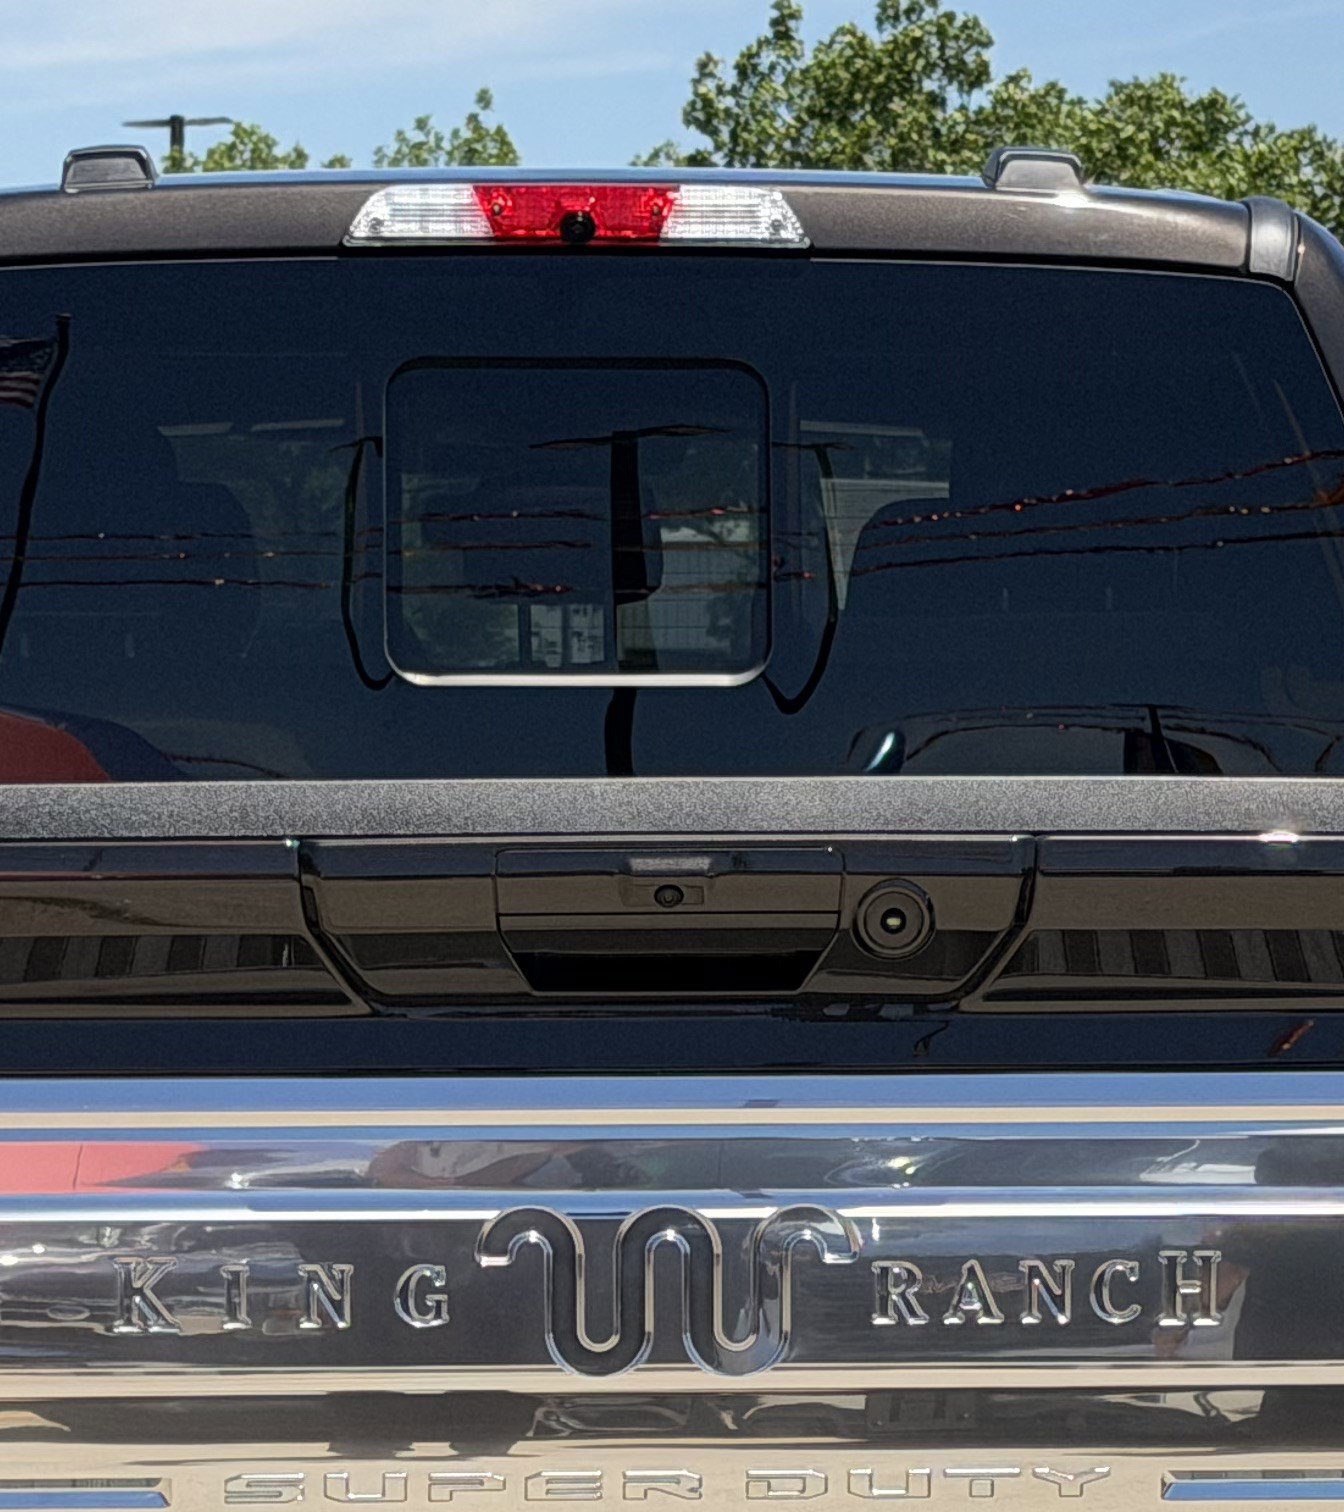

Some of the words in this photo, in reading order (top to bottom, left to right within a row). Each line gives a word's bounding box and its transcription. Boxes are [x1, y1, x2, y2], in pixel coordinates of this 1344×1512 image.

[112, 1253, 451, 1335] KING
[868, 1250, 1224, 1328] RANCH
[224, 1469, 704, 1504] SUPER
[744, 1466, 1112, 1500] DUTY
